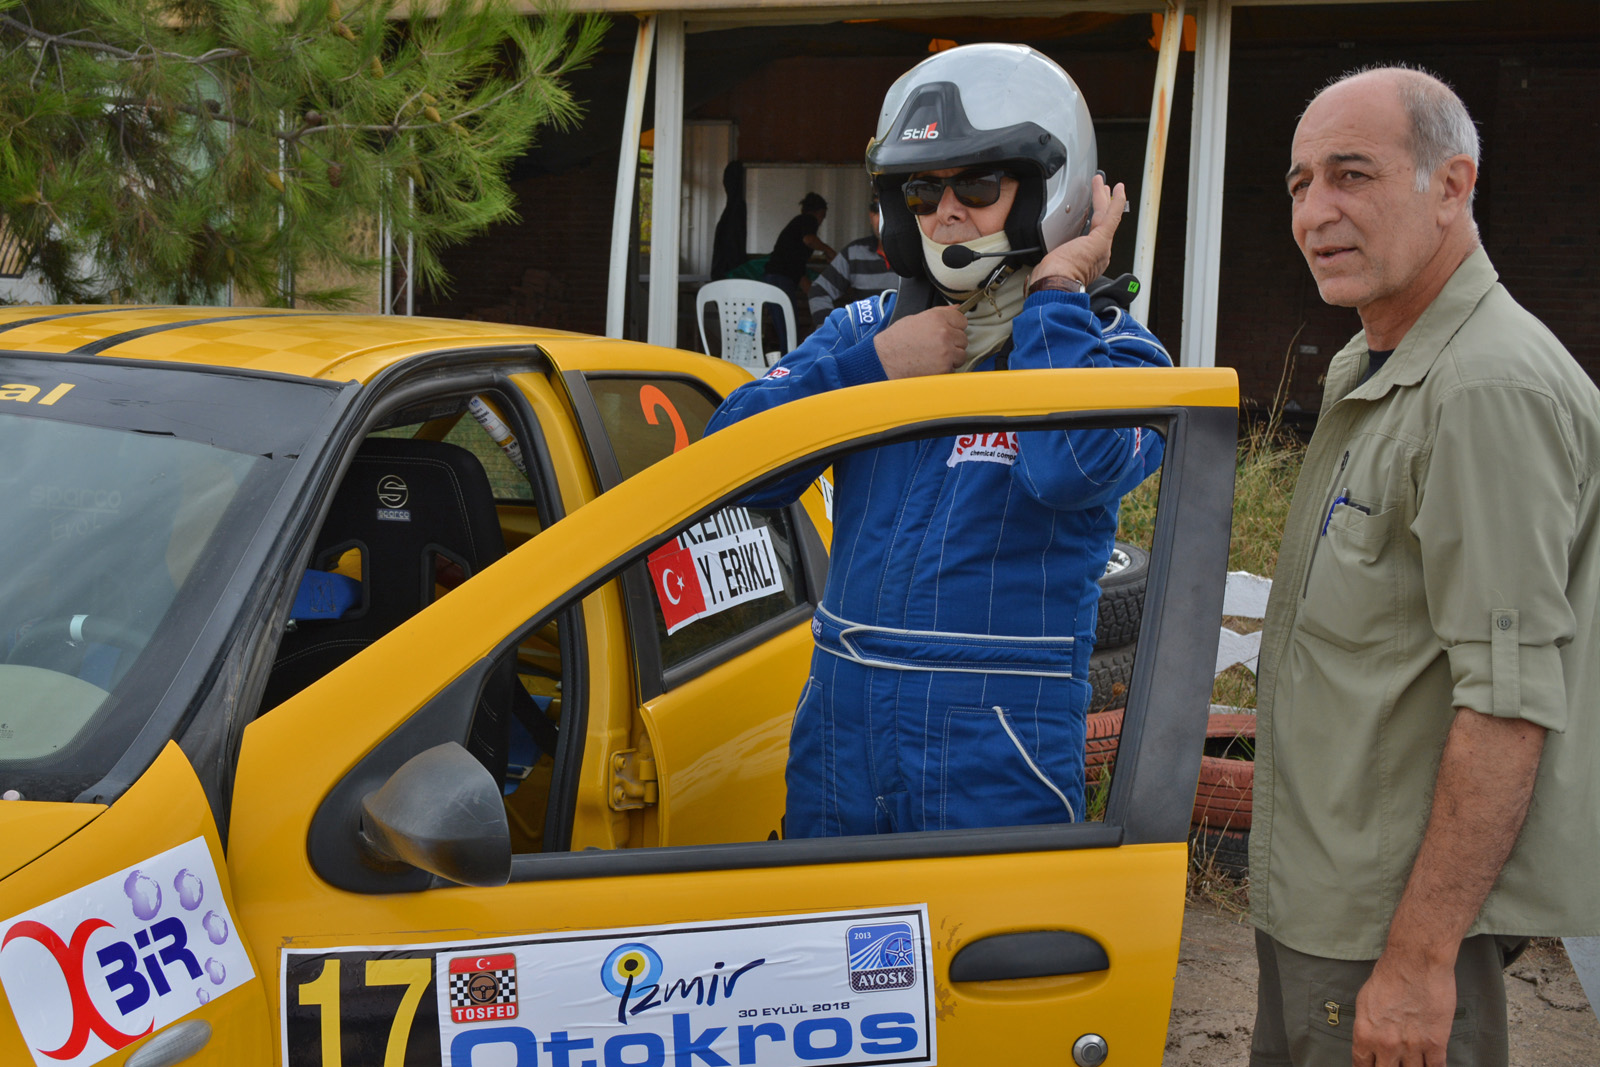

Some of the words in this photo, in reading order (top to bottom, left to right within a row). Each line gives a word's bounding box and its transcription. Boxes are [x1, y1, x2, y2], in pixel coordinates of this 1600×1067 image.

[901, 121, 939, 140] Stilo
[970, 449, 996, 457] chemical
[696, 554, 724, 605] Y.
[853, 931, 873, 941] 2013
[858, 971, 909, 987] AYOSK
[297, 957, 433, 1067] 17
[455, 1005, 516, 1022] TOSFED
[738, 1008, 758, 1018] 30
[762, 1002, 808, 1017] EYLÜL
[812, 1001, 851, 1012] 2018
[450, 1010, 919, 1067] Otokros
